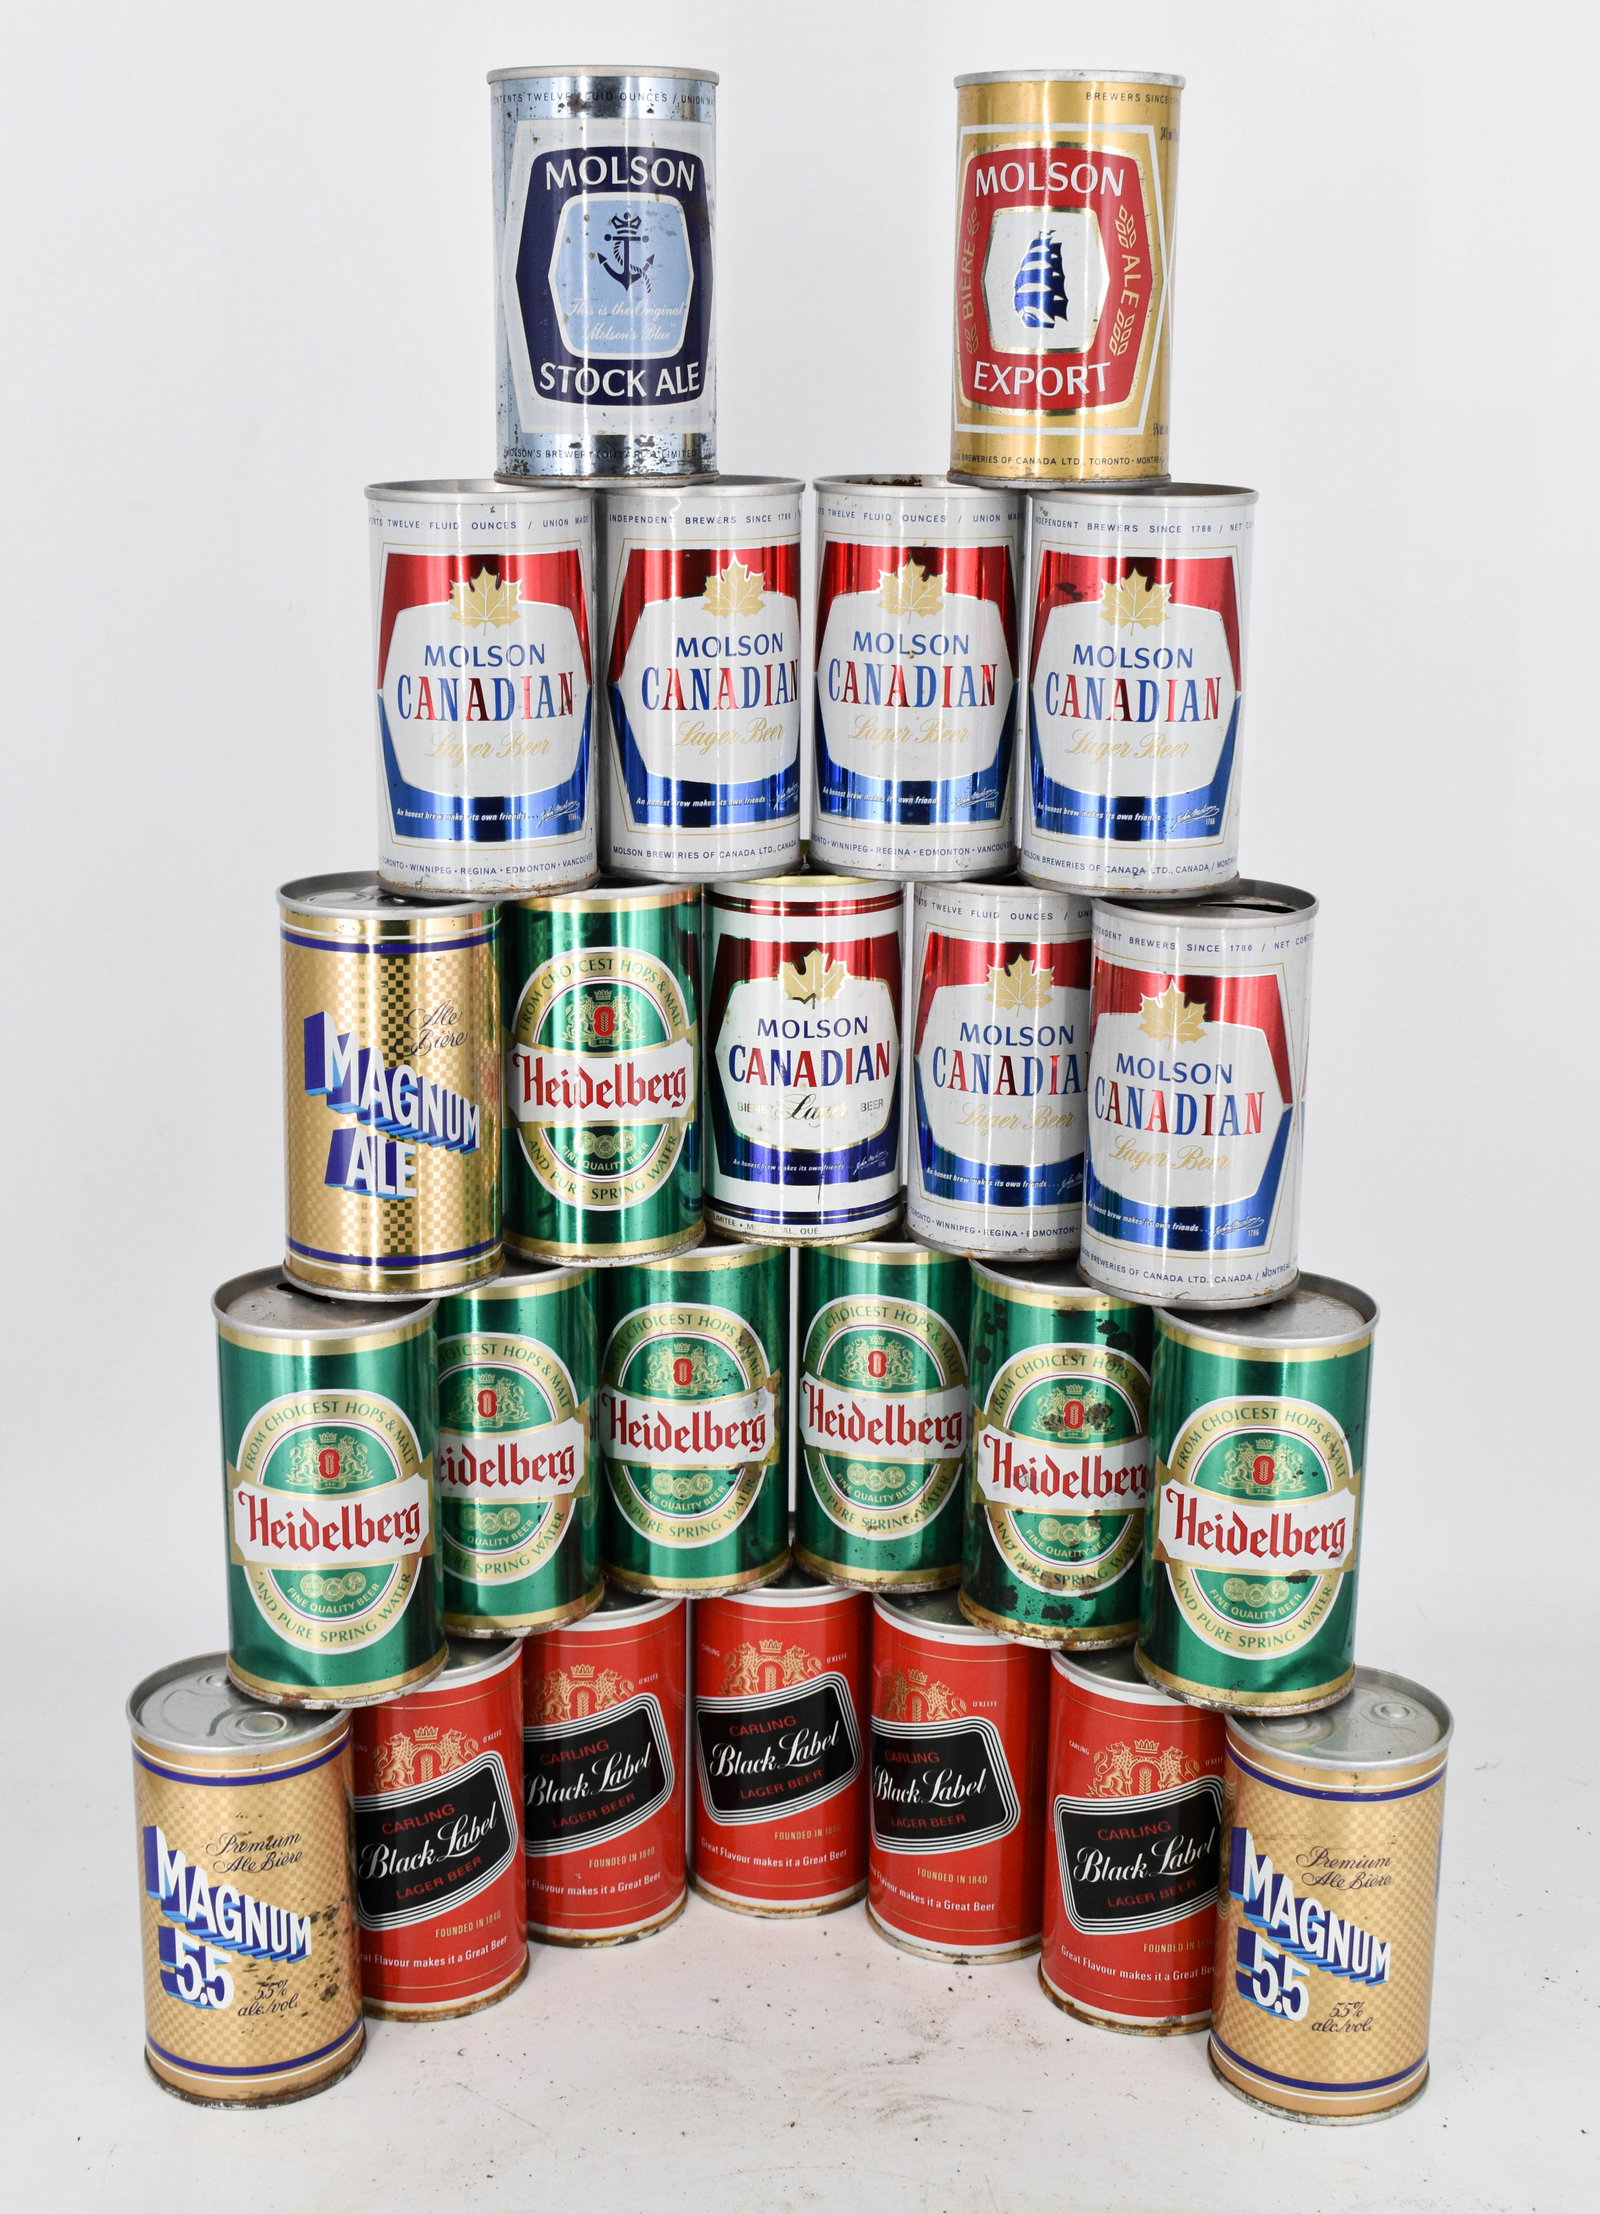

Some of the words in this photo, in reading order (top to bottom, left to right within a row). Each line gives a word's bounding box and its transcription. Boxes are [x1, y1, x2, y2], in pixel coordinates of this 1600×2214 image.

[620, 93, 667, 102] OUNCES
[1086, 92, 1141, 101] BREWERS
[1146, 95, 1168, 104] SINCE
[546, 156, 694, 191] MOLSON
[976, 162, 1124, 197] MOLSON
[1121, 254, 1141, 308] ALE
[599, 305, 606, 315] is
[635, 300, 684, 321] Original
[540, 362, 646, 397] STOCK
[655, 362, 699, 397] ALE
[973, 361, 1111, 396] EXPORT
[961, 455, 998, 464] BREWERIES
[1016, 456, 1056, 464] CANADA
[1089, 457, 1130, 465] TORONTO
[388, 519, 420, 528] TWELVE
[471, 521, 516, 530] OUNCES
[543, 518, 569, 527] UNION
[685, 516, 737, 525] BREWERS
[746, 515, 771, 523] SINCE
[902, 515, 946, 523] OUNCES
[1087, 522, 1138, 532] BREWERS
[424, 644, 545, 667] MOLSON
[676, 632, 783, 658] MOLSON
[853, 631, 969, 655] MOLSON
[1073, 644, 1193, 669] MOLSON
[397, 671, 575, 722] CANADIAN
[641, 659, 799, 711] CANADIAN
[828, 658, 998, 708] CANADIAN
[1046, 671, 1222, 723] CANADIAN
[675, 720, 740, 754] Lager
[742, 717, 784, 744] Beer
[848, 714, 913, 749] Lager
[914, 716, 970, 743] Beer
[1064, 728, 1134, 764] Lager
[1134, 732, 1190, 759] Beer
[424, 730, 494, 767] Lager
[496, 730, 552, 758] Beer
[405, 809, 424, 819] honest
[499, 812, 526, 821] friends
[1134, 813, 1161, 821] friends
[613, 846, 643, 857] MOLSON
[720, 849, 755, 858] CANADA
[830, 840, 868, 853] WINNIPEG
[919, 847, 970, 856] EDMONTON
[410, 863, 452, 874] WINNIPEG
[460, 867, 497, 875] REGINA
[506, 862, 556, 874] EDMONTON
[1042, 856, 1085, 870] BREWERIES
[1176, 863, 1209, 874] CANADA
[1010, 912, 1053, 920] OUNCES
[1129, 937, 1176, 950] BREWERS
[1187, 944, 1220, 952] SINCE
[541, 958, 614, 990] CHOICEST
[621, 959, 658, 983] HOPS
[407, 1000, 463, 1030] Ale
[757, 1016, 868, 1039] MOLSON
[393, 1028, 468, 1057] Bière
[960, 1022, 1074, 1046] MOLSON
[729, 1040, 890, 1087] CANADIAN
[933, 1045, 1090, 1096] CANADIA
[1116, 1053, 1233, 1084] MOLSON
[304, 1010, 480, 1154] MAGNUM
[512, 1053, 686, 1109] Heidelberg
[772, 1093, 848, 1128] Lager
[860, 1098, 884, 1113] BEER
[955, 1103, 1019, 1136] Lager
[1023, 1105, 1074, 1131] Beer
[1095, 1076, 1265, 1137] CANADIAN
[324, 1127, 417, 1200] ALE
[591, 1180, 646, 1200] SPRING
[647, 1135, 678, 1180] WATER
[1108, 1135, 1170, 1171] Lager
[1170, 1145, 1231, 1171] Beer
[1143, 1271, 1183, 1283] CANADA
[698, 1316, 737, 1337] HOPS
[825, 1306, 889, 1328] CHOICEST
[504, 1345, 543, 1367] HOPS
[1015, 1354, 1087, 1379] CHOICEST
[602, 1392, 766, 1453] Heidelberg
[803, 1381, 963, 1450] Heidelberg
[245, 1431, 266, 1471] FROM
[265, 1401, 339, 1432] CHOICEST
[345, 1402, 386, 1423] HOPS
[393, 1429, 415, 1464] MALT
[1177, 1431, 1202, 1470] FROM
[1202, 1407, 1279, 1432] CHOICEST
[1284, 1410, 1323, 1434] HOPS
[440, 1442, 575, 1488] idelberg
[238, 1490, 420, 1551] Heidelberg
[1166, 1488, 1346, 1559] Heidelberg
[310, 1601, 355, 1614] QUALITY
[357, 1583, 380, 1606] BEER
[320, 1620, 377, 1643] SPRING
[378, 1573, 411, 1620] WATER
[1232, 1607, 1276, 1619] QUALITY
[1279, 1594, 1302, 1616] BEER
[1239, 1630, 1295, 1648] SPRING
[1299, 1586, 1333, 1632] WATER
[729, 1715, 797, 1736] CARLING
[540, 1739, 609, 1765] CARLING
[710, 1742, 777, 1777] Black
[778, 1720, 839, 1769] Label
[885, 1751, 940, 1763] CARLING
[525, 1773, 590, 1807] Black
[591, 1742, 652, 1796] Label
[739, 1784, 784, 1799] LAGER
[788, 1768, 824, 1789] BEER
[874, 1765, 921, 1803] Black
[922, 1768, 987, 1807] Label
[382, 1803, 455, 1835] CARLING
[1097, 1820, 1172, 1841] CARLING
[206, 1832, 302, 1856] Premium
[359, 1839, 436, 1880] Black
[437, 1801, 498, 1862] Label
[1073, 1847, 1149, 1883] Black
[1149, 1827, 1216, 1876] Label
[213, 1855, 255, 1873] Ale
[255, 1850, 303, 1873] Bière
[720, 1847, 750, 1864] Flavour
[753, 1857, 783, 1867] makes
[802, 1856, 827, 1866] Great
[829, 1849, 848, 1861] Beer
[1296, 1845, 1392, 1870] Premium
[396, 1877, 444, 1899] LAGER
[448, 1856, 483, 1880] BEER
[917, 1867, 954, 1884] FOUNDED
[968, 1875, 988, 1884] 1840
[1301, 1871, 1345, 1888] Ale
[1345, 1872, 1392, 1890] Bière
[143, 1825, 312, 1963] MAGNUM
[944, 1900, 970, 1911] Great
[973, 1902, 995, 1912] Beer
[1108, 1893, 1155, 1908] LAGER
[1159, 1879, 1197, 1898] BEER
[1229, 1826, 1392, 1986] MAGNUM
[158, 1925, 235, 2009] 5.5
[466, 1948, 489, 1961] Great
[1082, 1957, 1116, 1975] Flavour
[1235, 1927, 1310, 2021] 5.5
